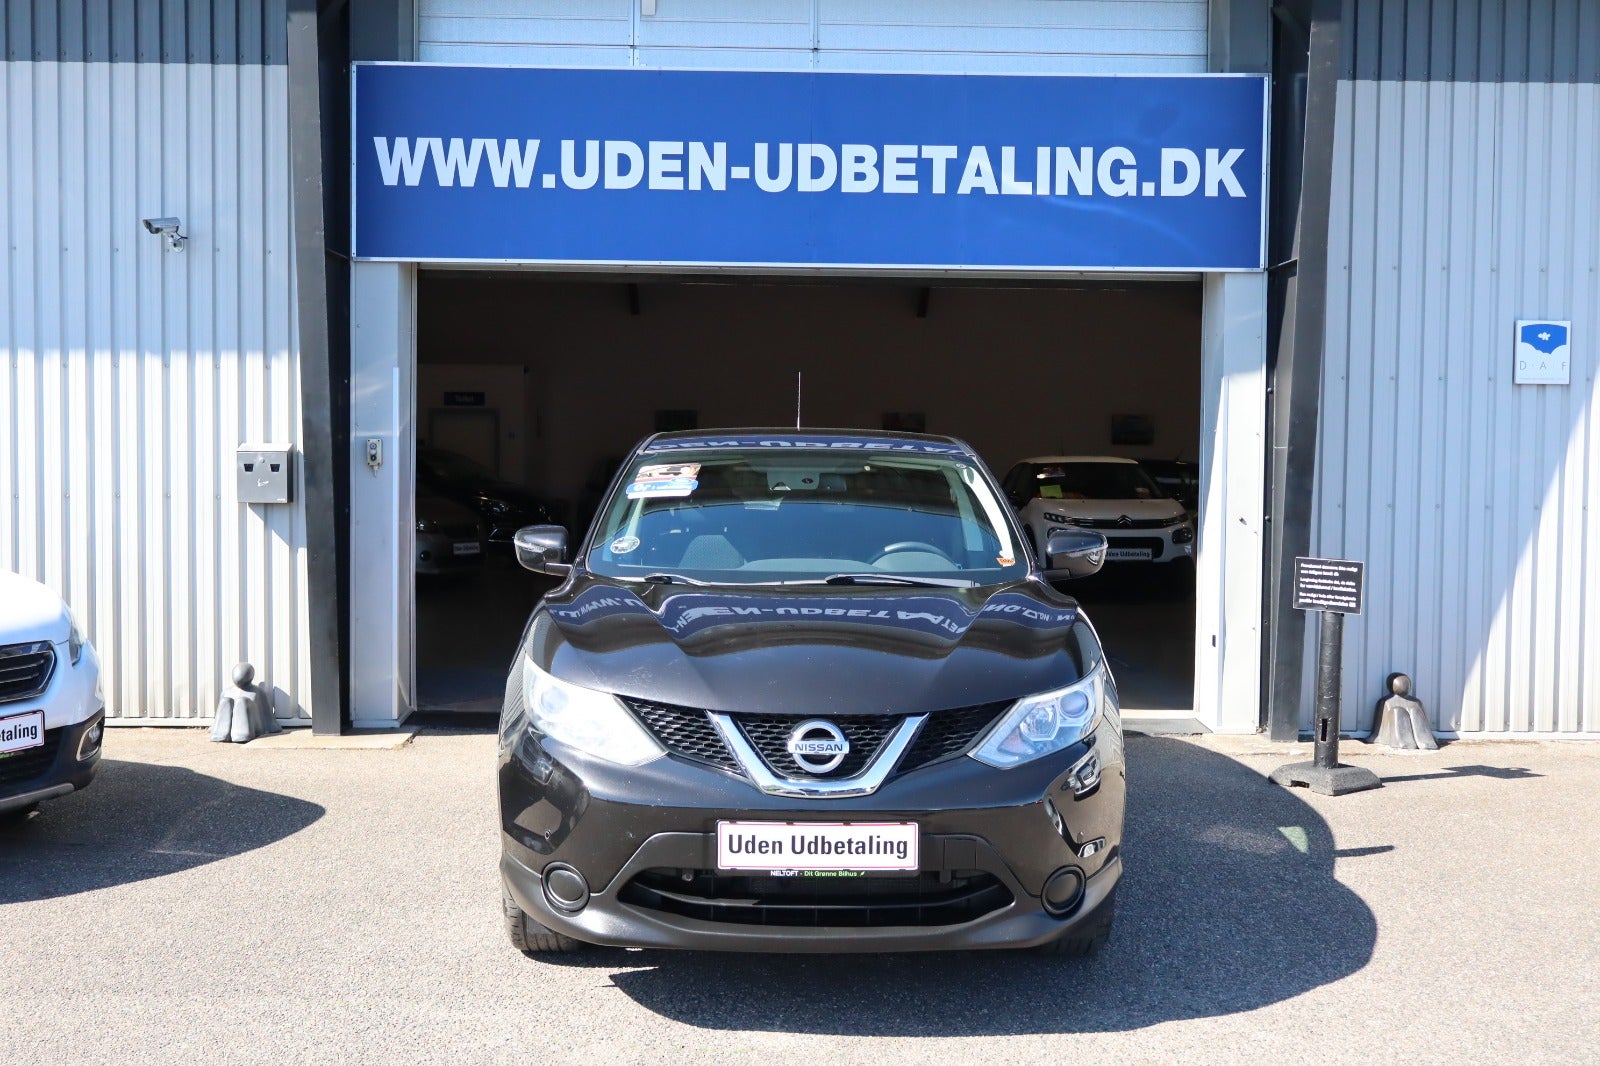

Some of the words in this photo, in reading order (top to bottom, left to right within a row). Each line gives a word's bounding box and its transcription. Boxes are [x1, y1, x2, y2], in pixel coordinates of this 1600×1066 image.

[373, 135, 1247, 198] WWW.UDEN-UDBETALING.DK
[0, 724, 37, 742] taling
[794, 743, 843, 752] NISSAN
[728, 834, 783, 855] Uden
[791, 835, 909, 860] Udbetaling
